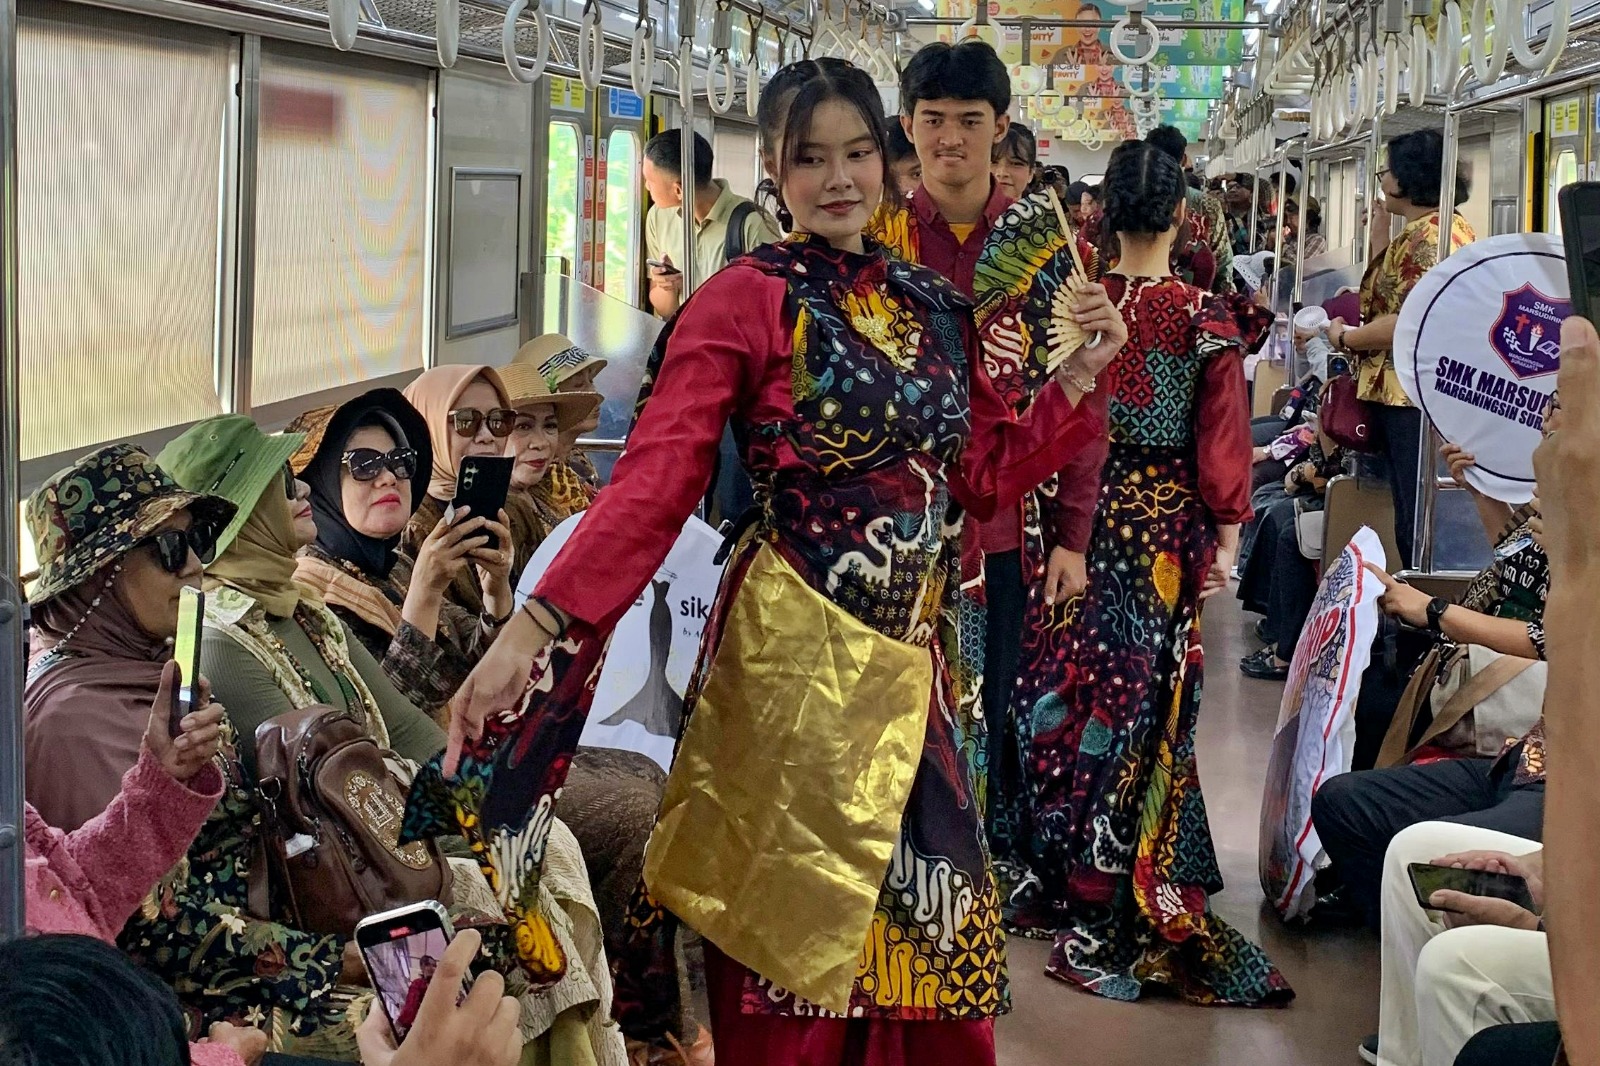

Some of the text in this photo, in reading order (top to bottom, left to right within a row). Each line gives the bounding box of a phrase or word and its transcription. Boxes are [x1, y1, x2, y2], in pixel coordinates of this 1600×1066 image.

[1533, 301, 1556, 315] SMK
[1435, 356, 1477, 389] SMK
[1434, 377, 1544, 432] MARGANINGSIH SUR
